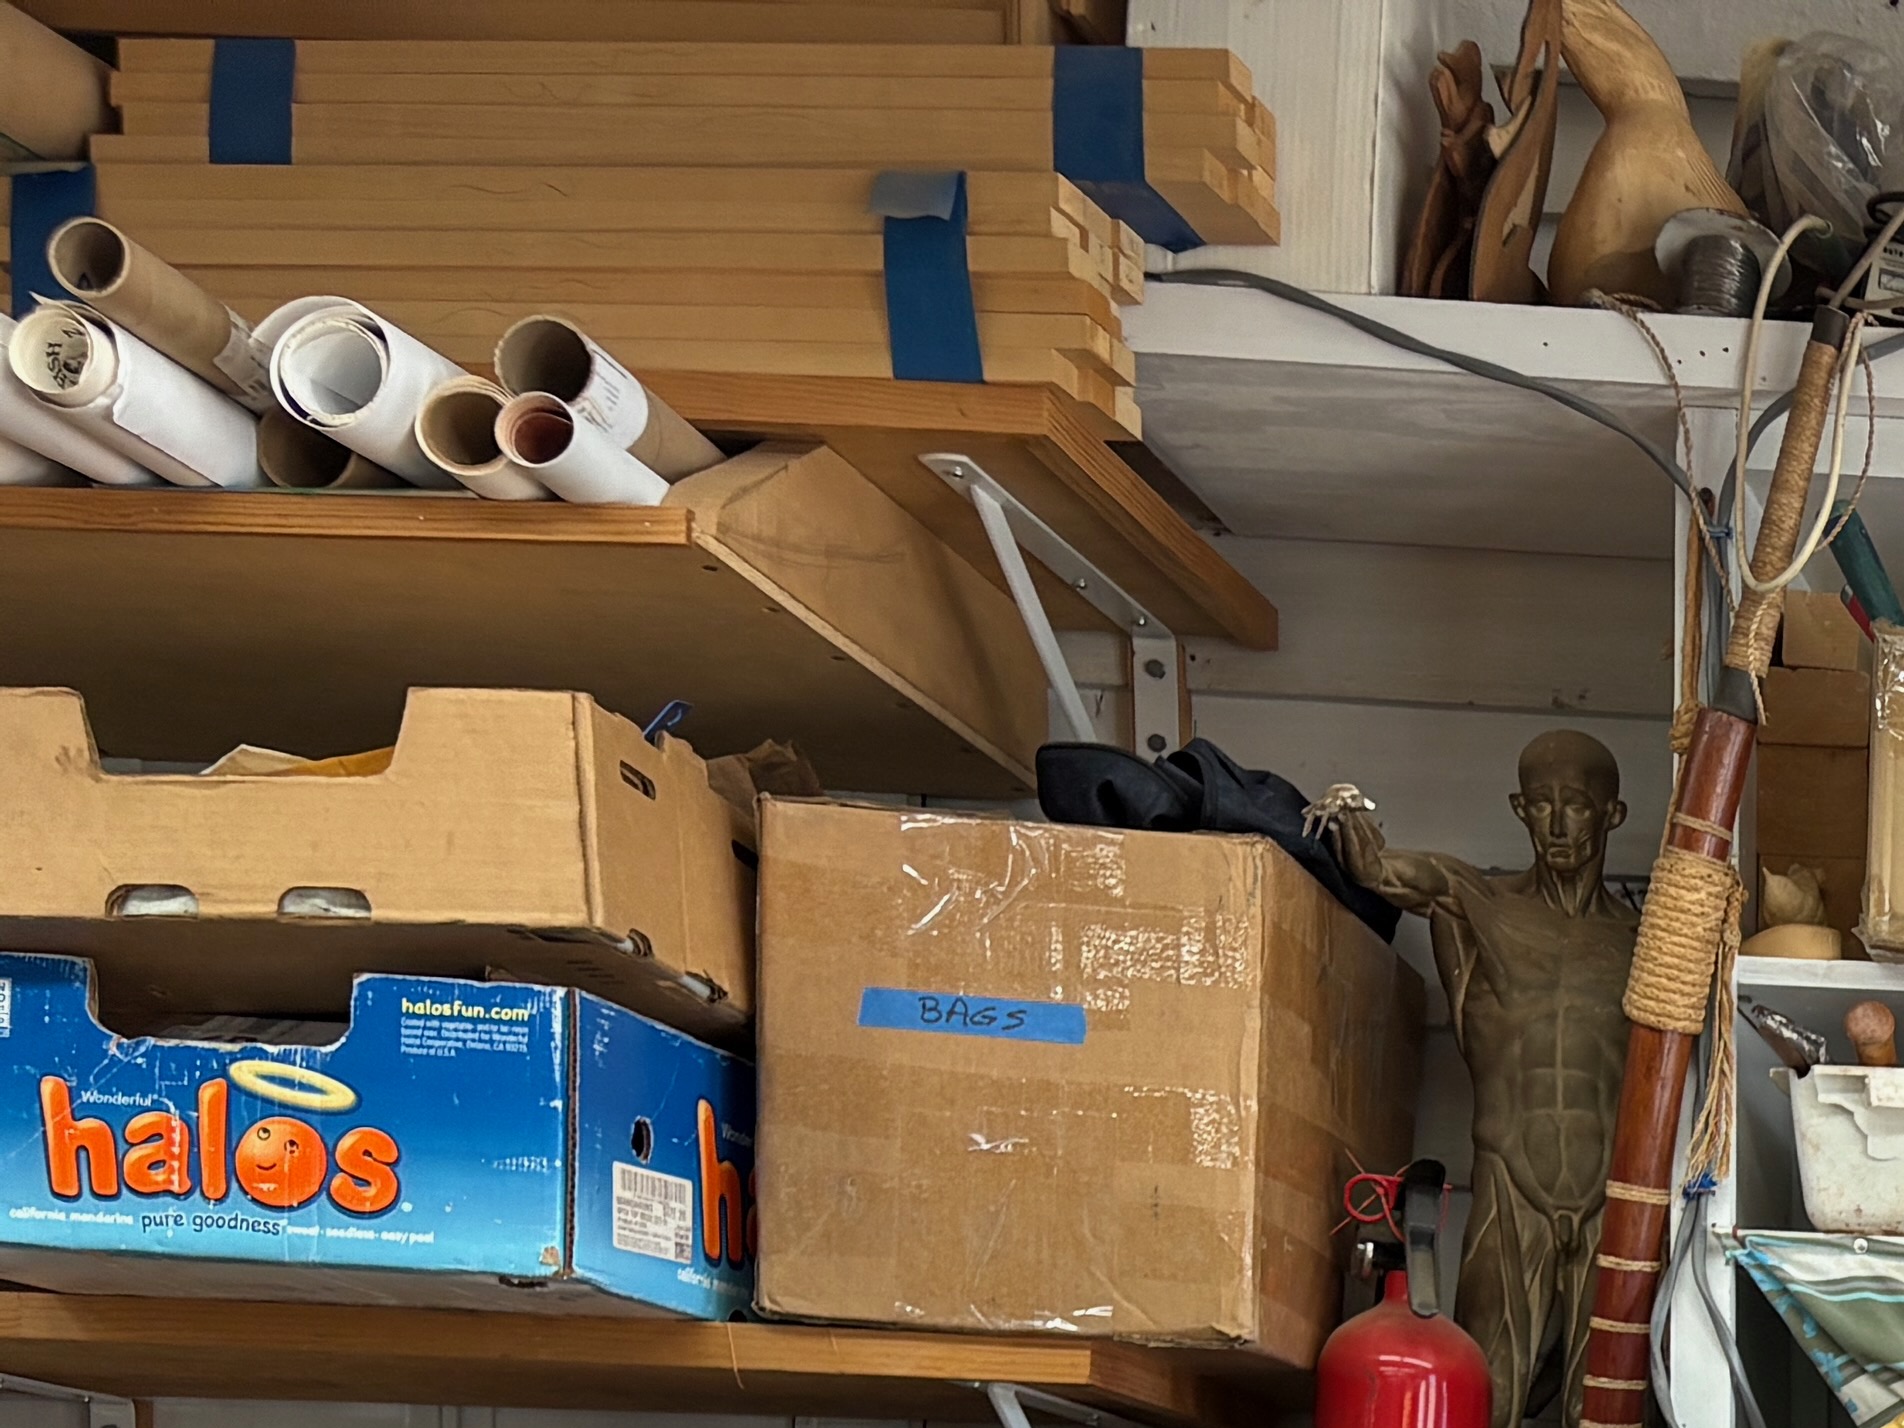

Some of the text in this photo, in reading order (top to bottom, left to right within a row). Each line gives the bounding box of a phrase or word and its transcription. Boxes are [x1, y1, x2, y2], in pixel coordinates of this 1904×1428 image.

[401, 997, 529, 1021] halosfun.com
[918, 996, 1027, 1030] BAGS
[81, 1090, 155, 1107] Wonderful
[39, 1075, 399, 1213] halos
[9, 1208, 67, 1222] california
[141, 1211, 282, 1236] pure goodness
